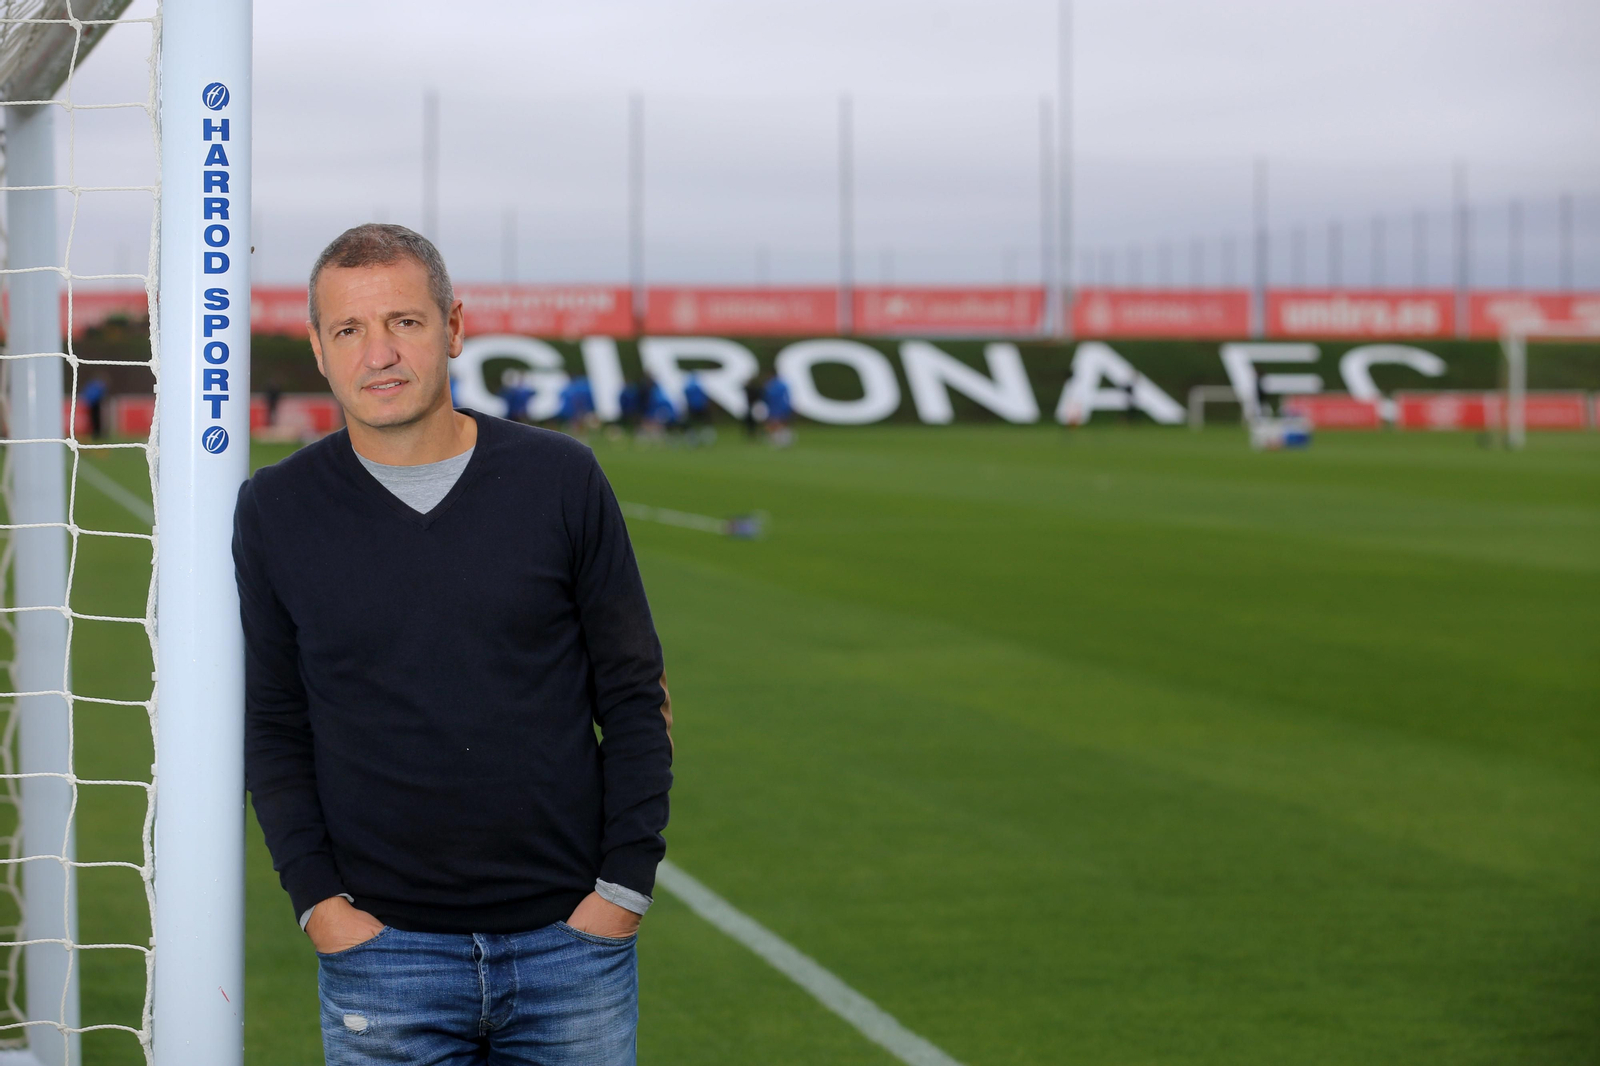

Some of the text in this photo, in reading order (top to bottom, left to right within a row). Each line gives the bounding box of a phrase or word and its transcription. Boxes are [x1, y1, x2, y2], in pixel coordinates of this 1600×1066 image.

[203, 118, 230, 419] HARROD SPORT
[449, 334, 1448, 425] GIRONA FC
